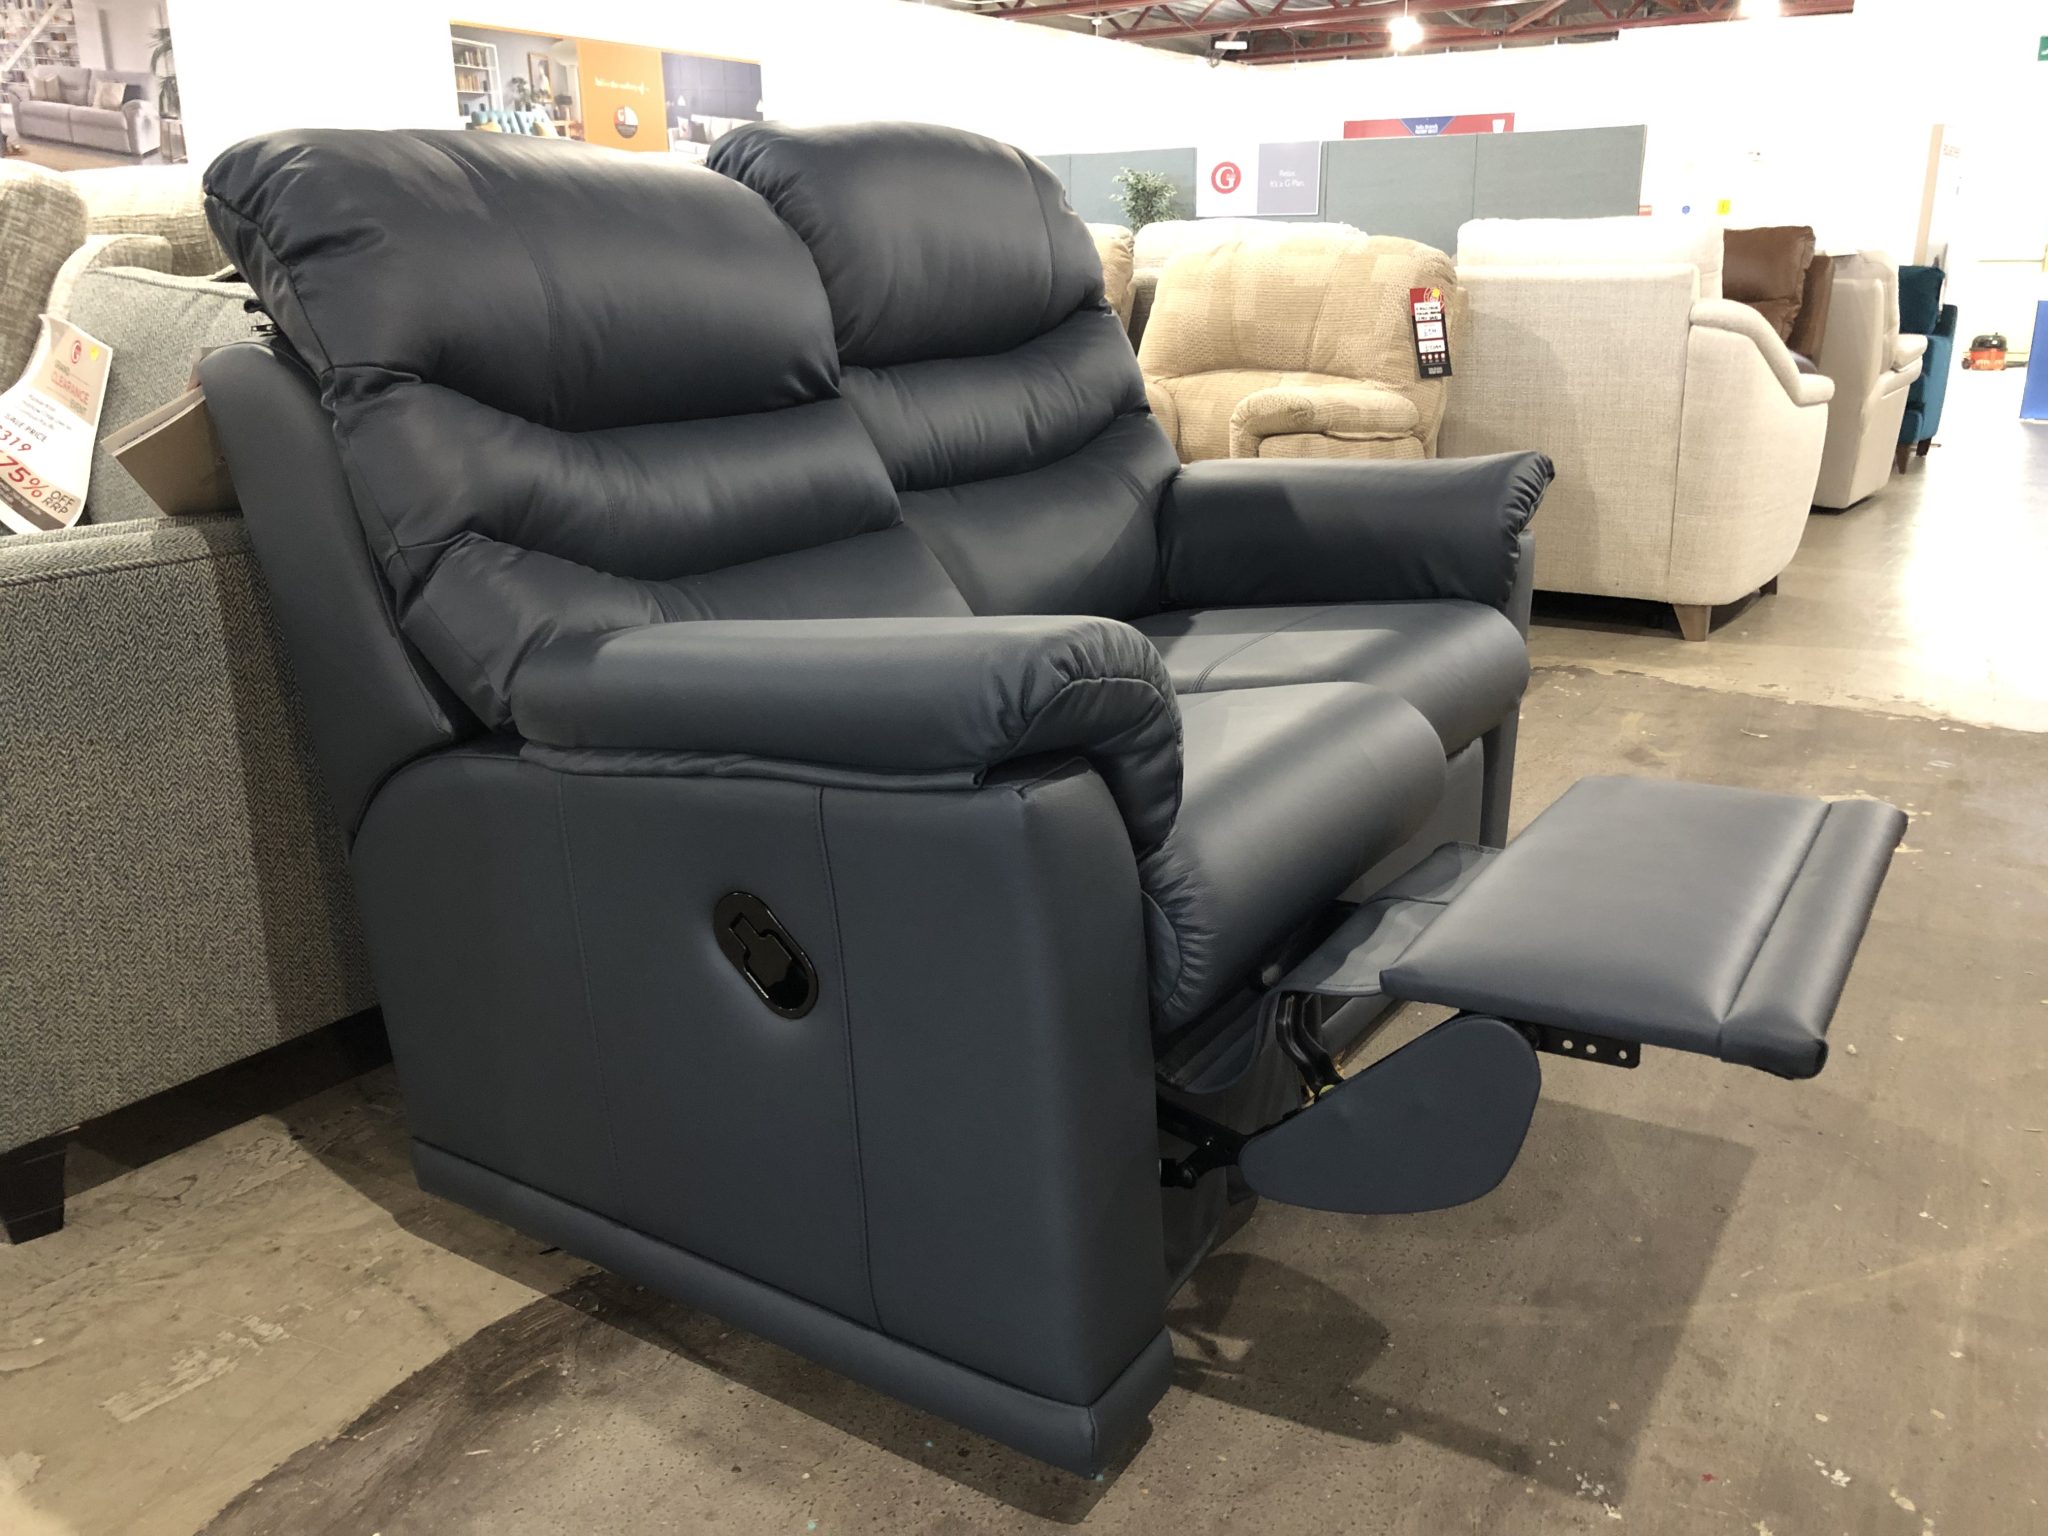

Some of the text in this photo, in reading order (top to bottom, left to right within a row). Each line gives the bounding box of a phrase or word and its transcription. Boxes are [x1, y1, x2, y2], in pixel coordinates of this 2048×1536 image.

[51, 371, 90, 406] CLEARANCE
[0, 425, 32, 452] 319
[25, 425, 48, 442] PRICE
[0, 455, 49, 499] 75%
[41, 497, 69, 516] RRP
[50, 489, 76, 508] OFF
